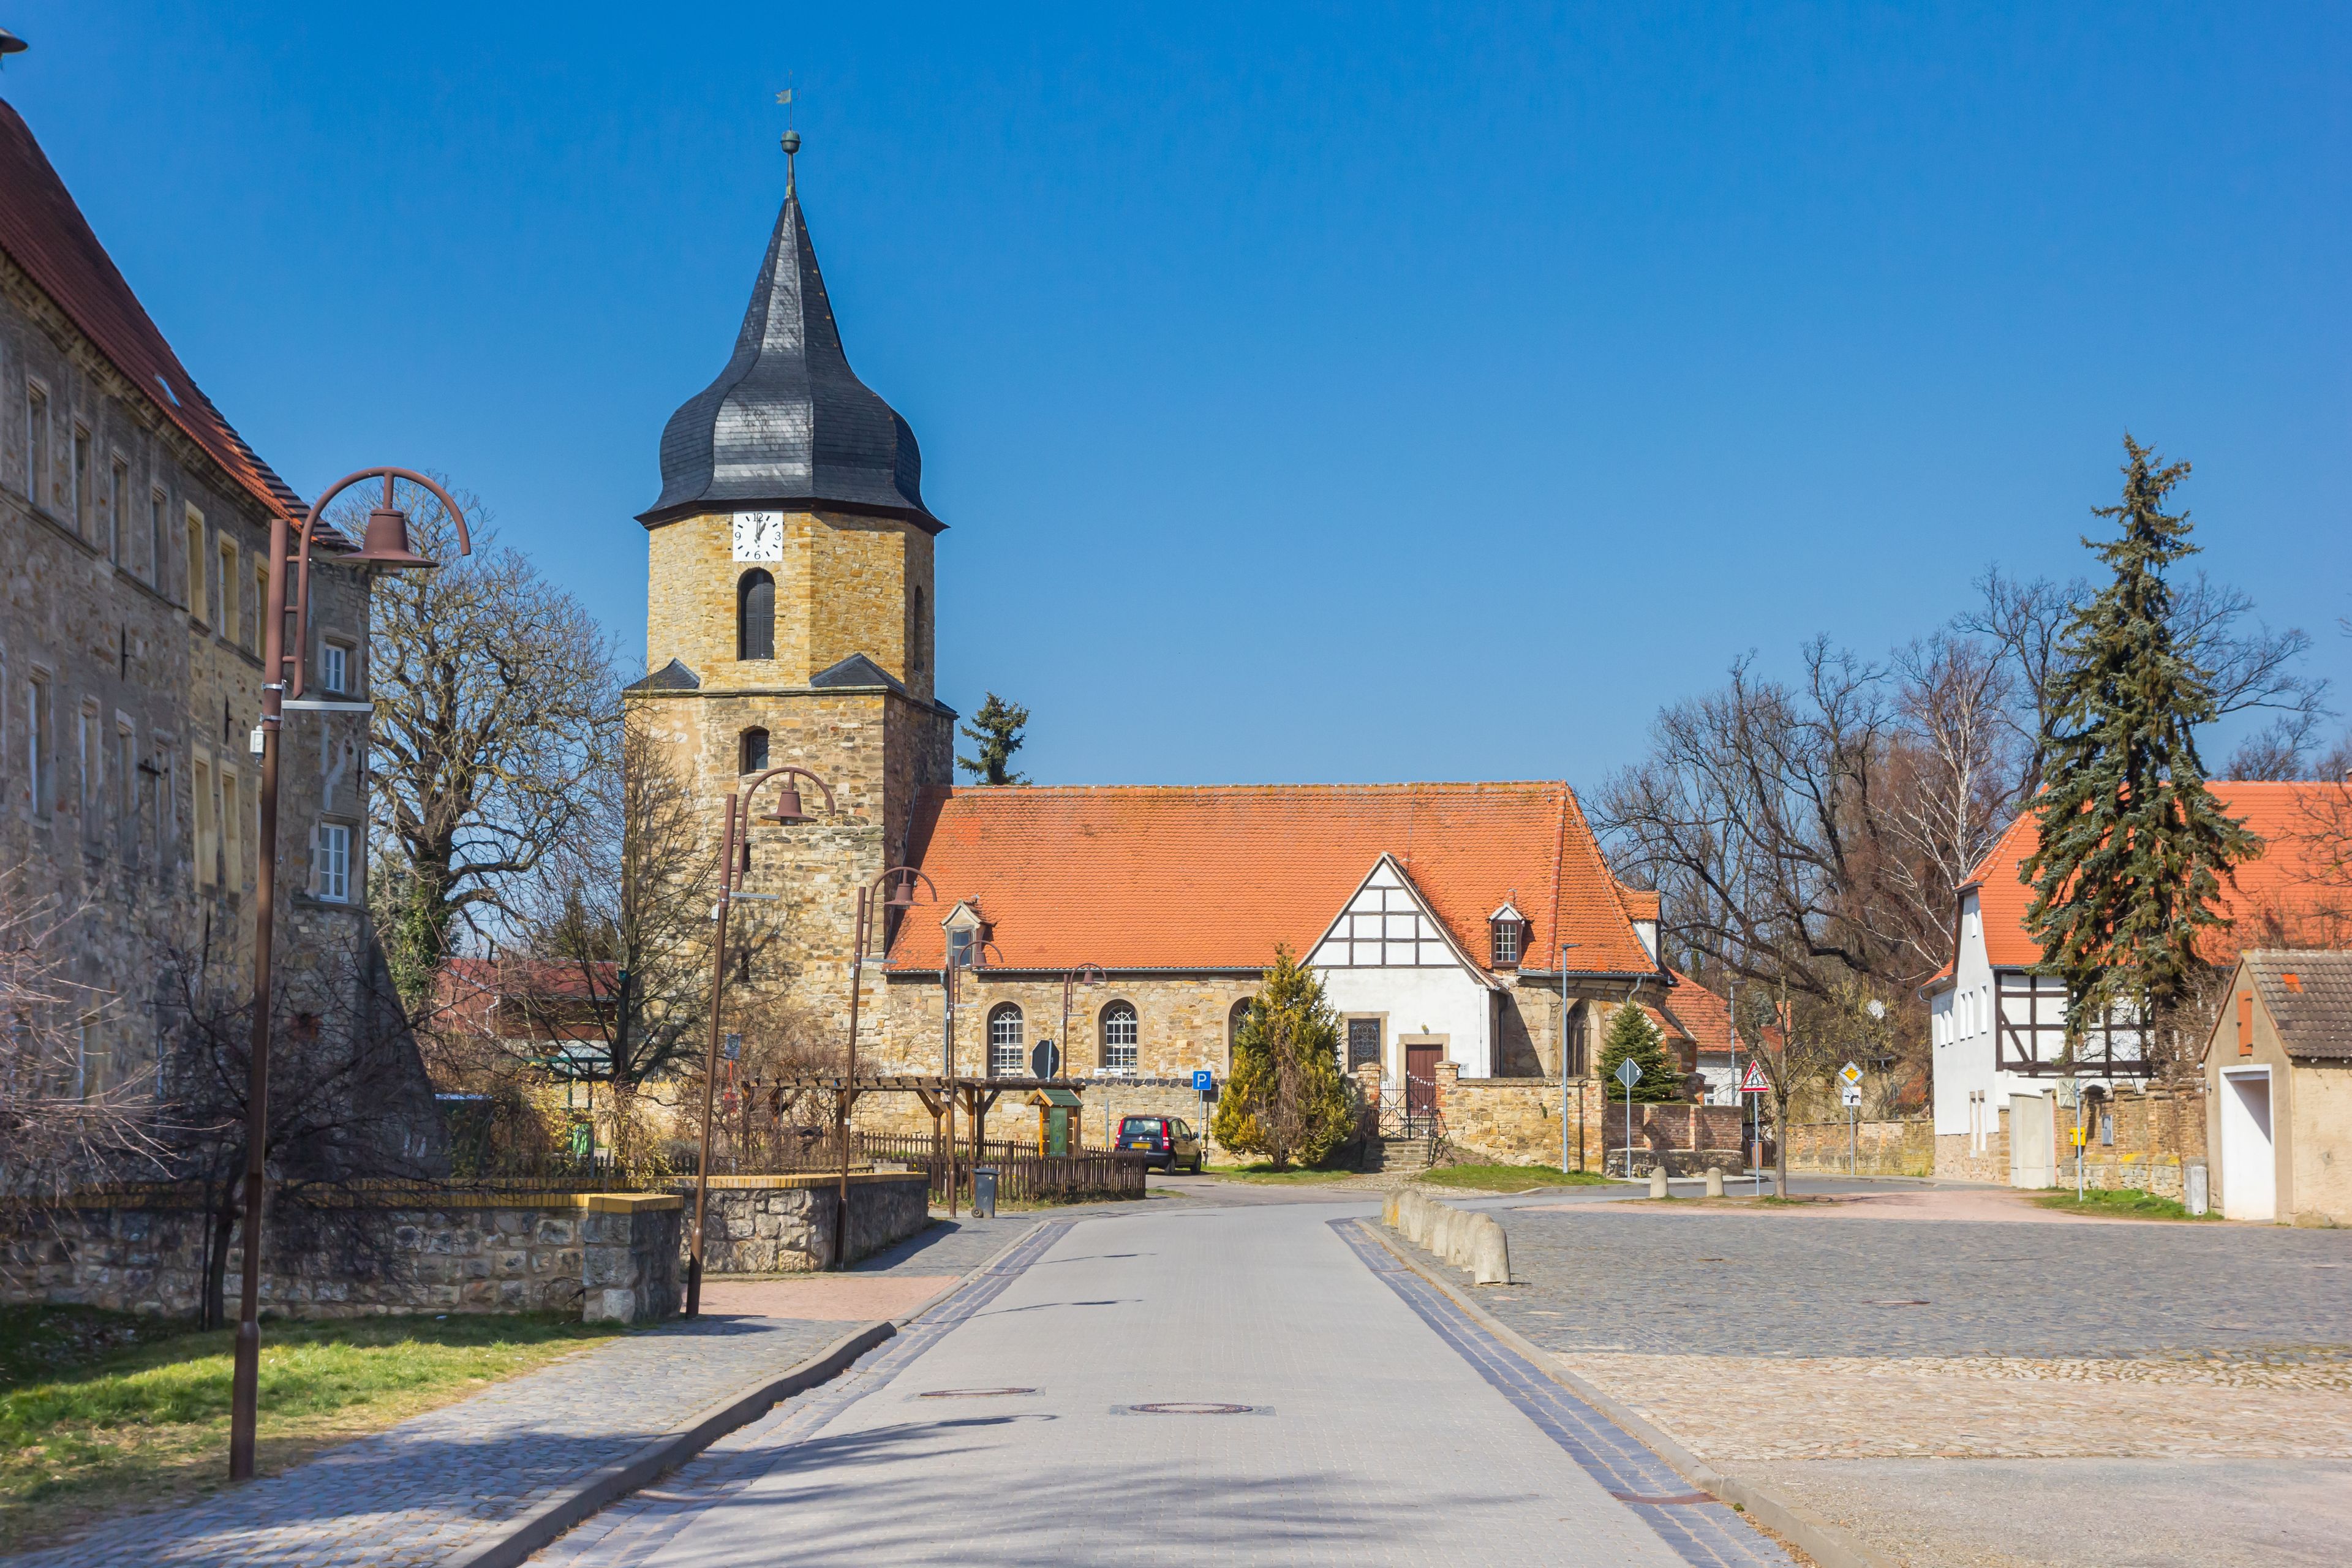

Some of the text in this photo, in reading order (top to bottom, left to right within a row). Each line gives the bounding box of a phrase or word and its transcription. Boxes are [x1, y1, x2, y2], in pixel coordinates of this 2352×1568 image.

[753, 512, 763, 522] 12
[734, 532, 741, 541] 9
[774, 531, 781, 541] 3
[754, 551, 761, 560] 6
[1197, 1073, 1207, 1087] P
